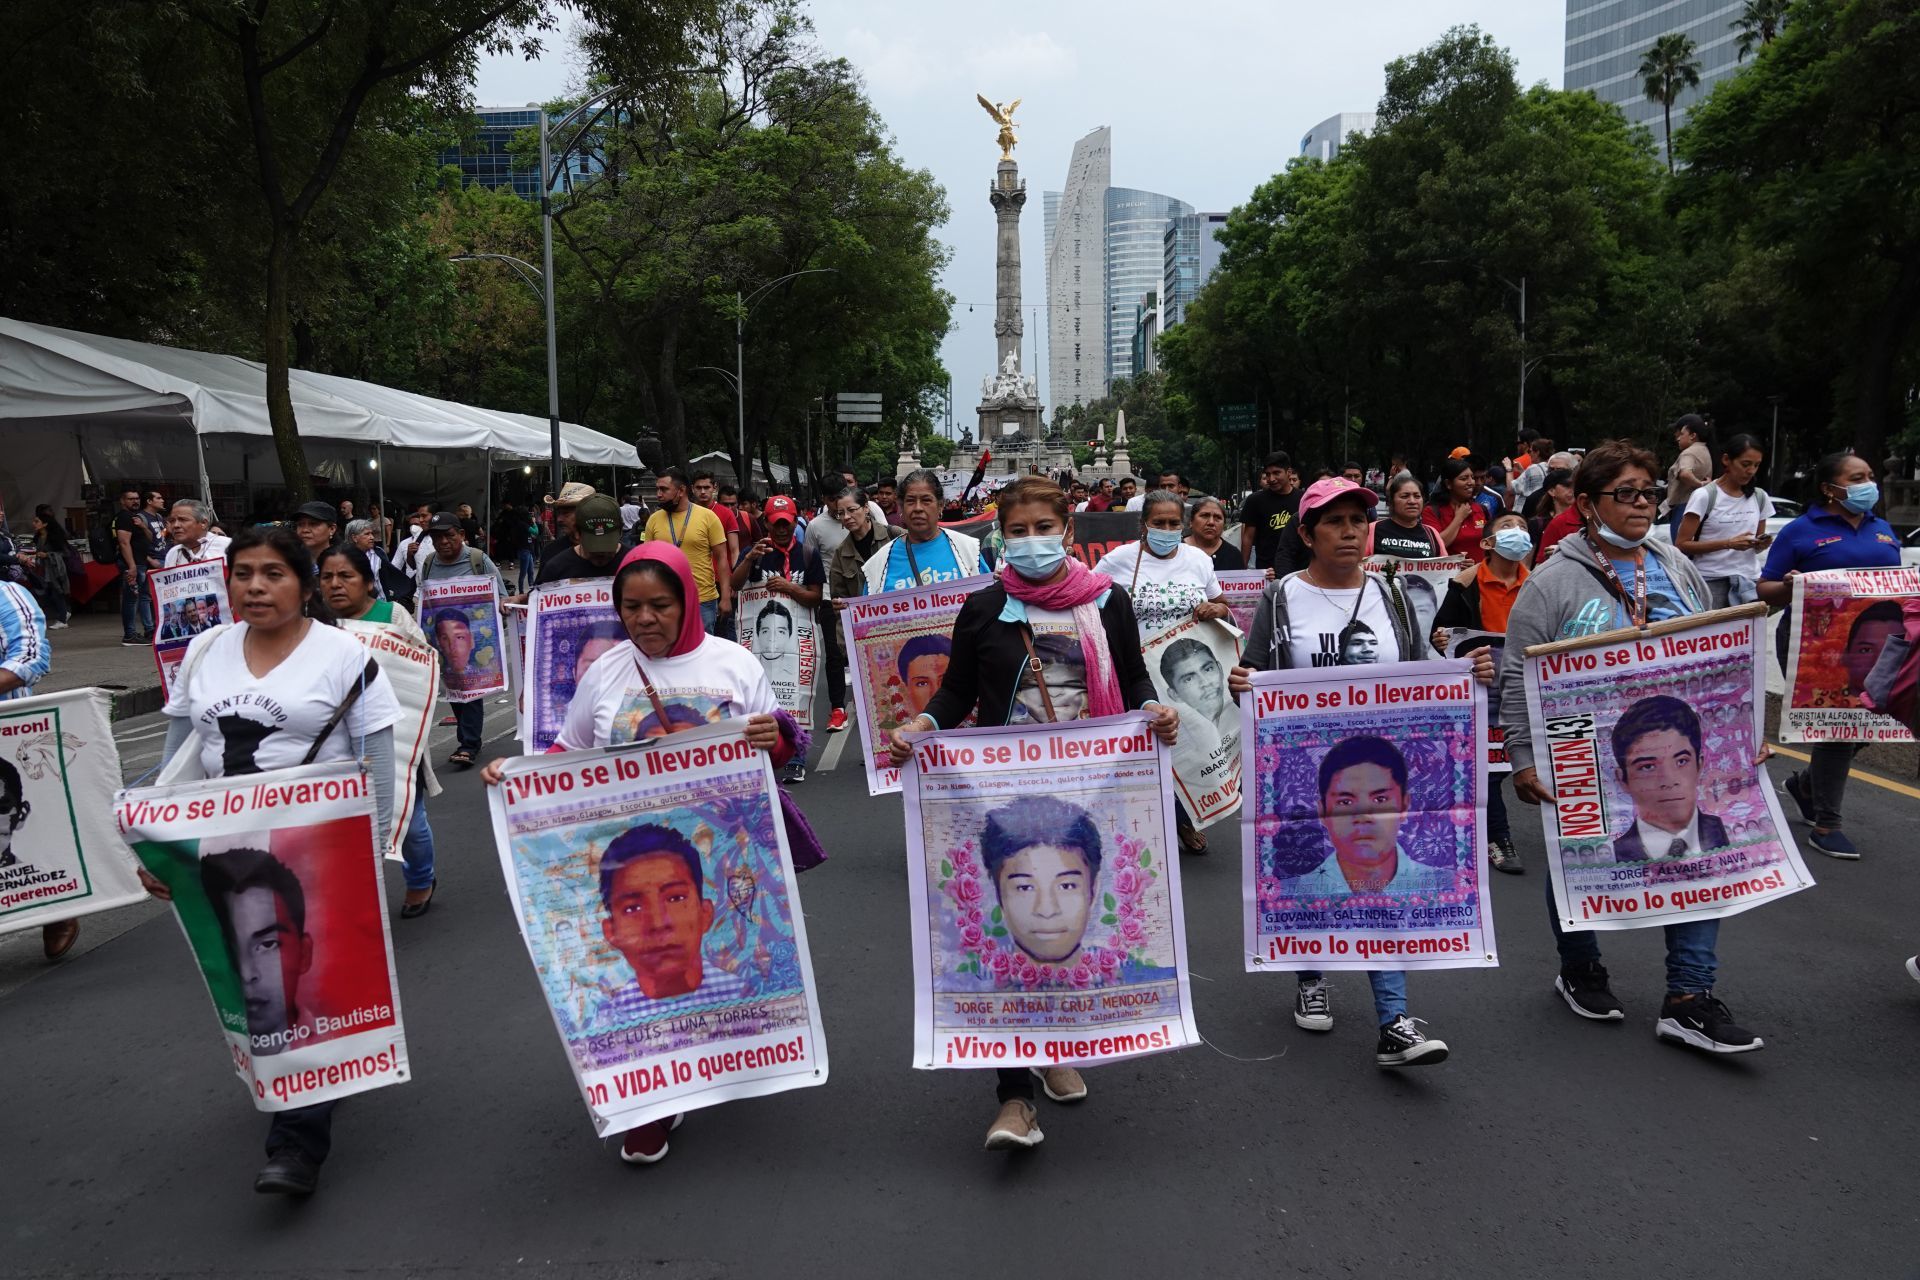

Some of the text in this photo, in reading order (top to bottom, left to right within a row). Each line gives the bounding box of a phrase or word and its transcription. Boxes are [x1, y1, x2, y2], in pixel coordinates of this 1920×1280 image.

[163, 566, 210, 586] JUZGARLOS
[440, 586, 449, 596] lo
[450, 582, 492, 595] llevaron!
[540, 589, 610, 612] ¡Vivo se lo
[760, 591, 768, 600] se
[852, 604, 889, 623] ¡Vivo
[892, 601, 910, 614] se
[913, 596, 927, 610] lo
[370, 634, 431, 667] llevaron!
[799, 638, 815, 670] FALTAN
[1540, 624, 1751, 682] ¡Vivo se lo llevaron!
[799, 669, 813, 686] NOS
[200, 693, 289, 725] FRENTE UNIDO
[1256, 678, 1471, 719] ¡Vivo se lo llevaron!
[1381, 716, 1405, 726] quiero
[1430, 712, 1451, 721] dónde
[1454, 712, 1472, 721] está
[1545, 713, 1595, 740] 43!
[1788, 711, 1863, 721] CHRISTIAN ALFONSO
[1805, 719, 1814, 727] de
[1816, 719, 1850, 727] Clemente
[1802, 726, 1827, 742] ¡Con
[1831, 726, 1859, 739] VIDA
[1863, 726, 1874, 739] lo
[918, 726, 1154, 774] ¡Vivo se lo llevaron!
[505, 769, 575, 806] ¡Vivo
[583, 764, 610, 788] se
[614, 756, 640, 782] lo
[925, 783, 935, 791] Yo
[936, 782, 949, 791] Jan
[978, 778, 1014, 789] Glasgow,
[1057, 774, 1085, 785] quiero
[1087, 771, 1111, 781] saber
[1112, 768, 1136, 779] dónde
[1136, 768, 1155, 777] está
[1551, 738, 1598, 799] FALTAN
[115, 773, 370, 835] ¡Vivo se lo llevaron!
[515, 822, 532, 833] Yo,
[533, 819, 550, 830] Jan
[659, 794, 688, 807] quiero
[690, 789, 715, 800] saber
[716, 784, 740, 796] dónde
[742, 780, 762, 792] está
[1198, 790, 1221, 813] ¡Con
[1558, 801, 1603, 837] NOS
[1610, 866, 1651, 882] JORGE
[1657, 859, 1713, 877] ÁLVAREZ
[1718, 851, 1748, 868] NAVA
[1, 878, 79, 908] queremos!
[1574, 884, 1592, 892] Hijo
[1581, 868, 1786, 920] ¡Vivo lo queremos!
[1265, 906, 1473, 924] GIOVANNI GALINDREZ GUERRERO
[1265, 924, 1282, 932] Hijo
[1446, 919, 1474, 928] Arcelia
[1268, 932, 1471, 960] ¡Vivo lo queremos!
[954, 1001, 994, 1015] JORGE
[1060, 999, 1096, 1013] CRUZ
[1102, 991, 1160, 1009] MENDOZA
[314, 1003, 392, 1036] Bautista
[671, 1015, 708, 1034] LUNA
[715, 1004, 768, 1025] TORRES
[967, 1017, 987, 1026] Hijo
[1002, 1017, 1031, 1025] Carmen
[1057, 1015, 1077, 1024] Años
[673, 1036, 694, 1048] años
[946, 1024, 1172, 1064] ¡Vivo lo queremos!
[272, 1043, 398, 1103] queremos!
[613, 1063, 668, 1099] VIDA
[671, 1058, 693, 1086] lo
[697, 1035, 805, 1082] queremos!
